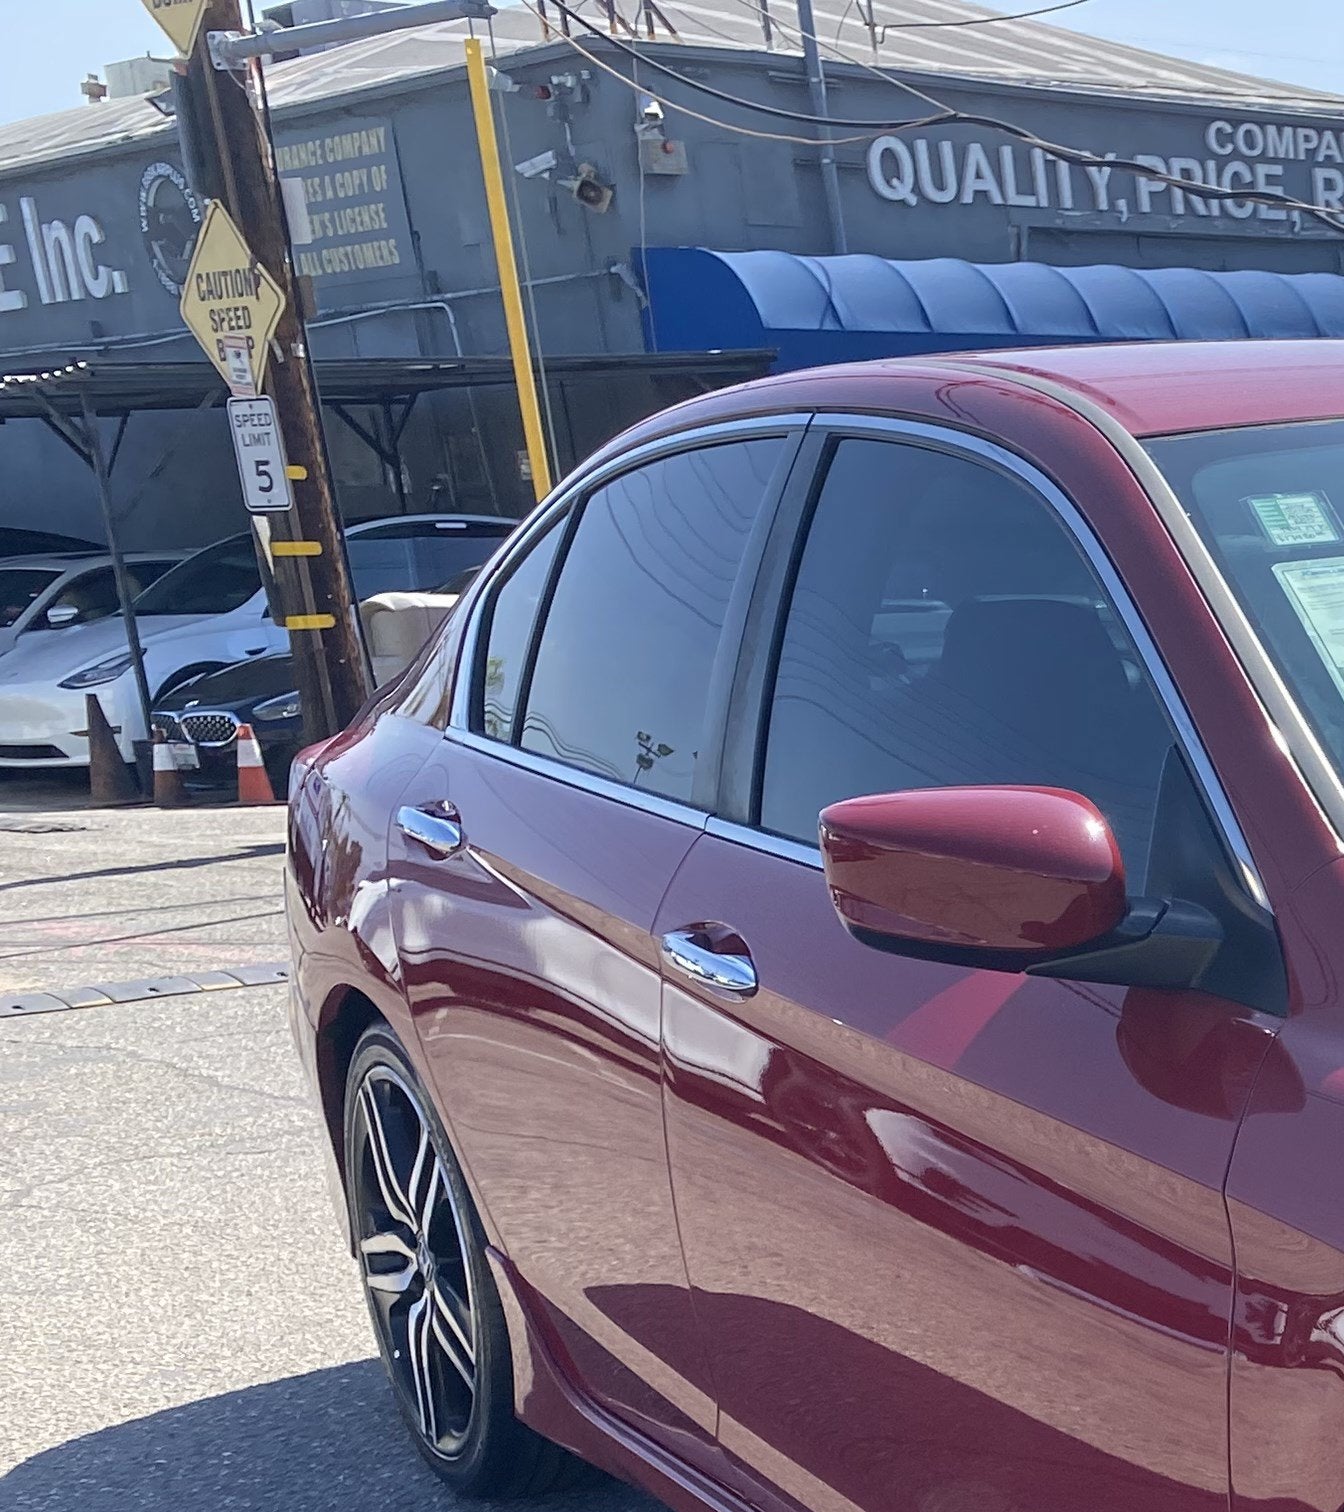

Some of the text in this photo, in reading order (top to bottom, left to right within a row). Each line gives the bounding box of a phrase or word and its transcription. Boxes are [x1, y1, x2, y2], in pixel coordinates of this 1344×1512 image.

[325, 127, 386, 163] COMPANY
[335, 168, 369, 198] COPY
[370, 164, 388, 192] OF
[866, 135, 1129, 222] QUALITY,
[1133, 154, 1301, 232] PRICE,
[334, 202, 388, 236] LICENSE
[20, 196, 130, 305] Inc.
[322, 238, 400, 274] CUSTOMERS
[195, 268, 256, 302] CAUTION
[208, 305, 252, 333] SPEED
[216, 335, 256, 362] BP
[234, 412, 272, 429] SPEED
[241, 432, 271, 447] LIMIT
[254, 459, 274, 493] 5
